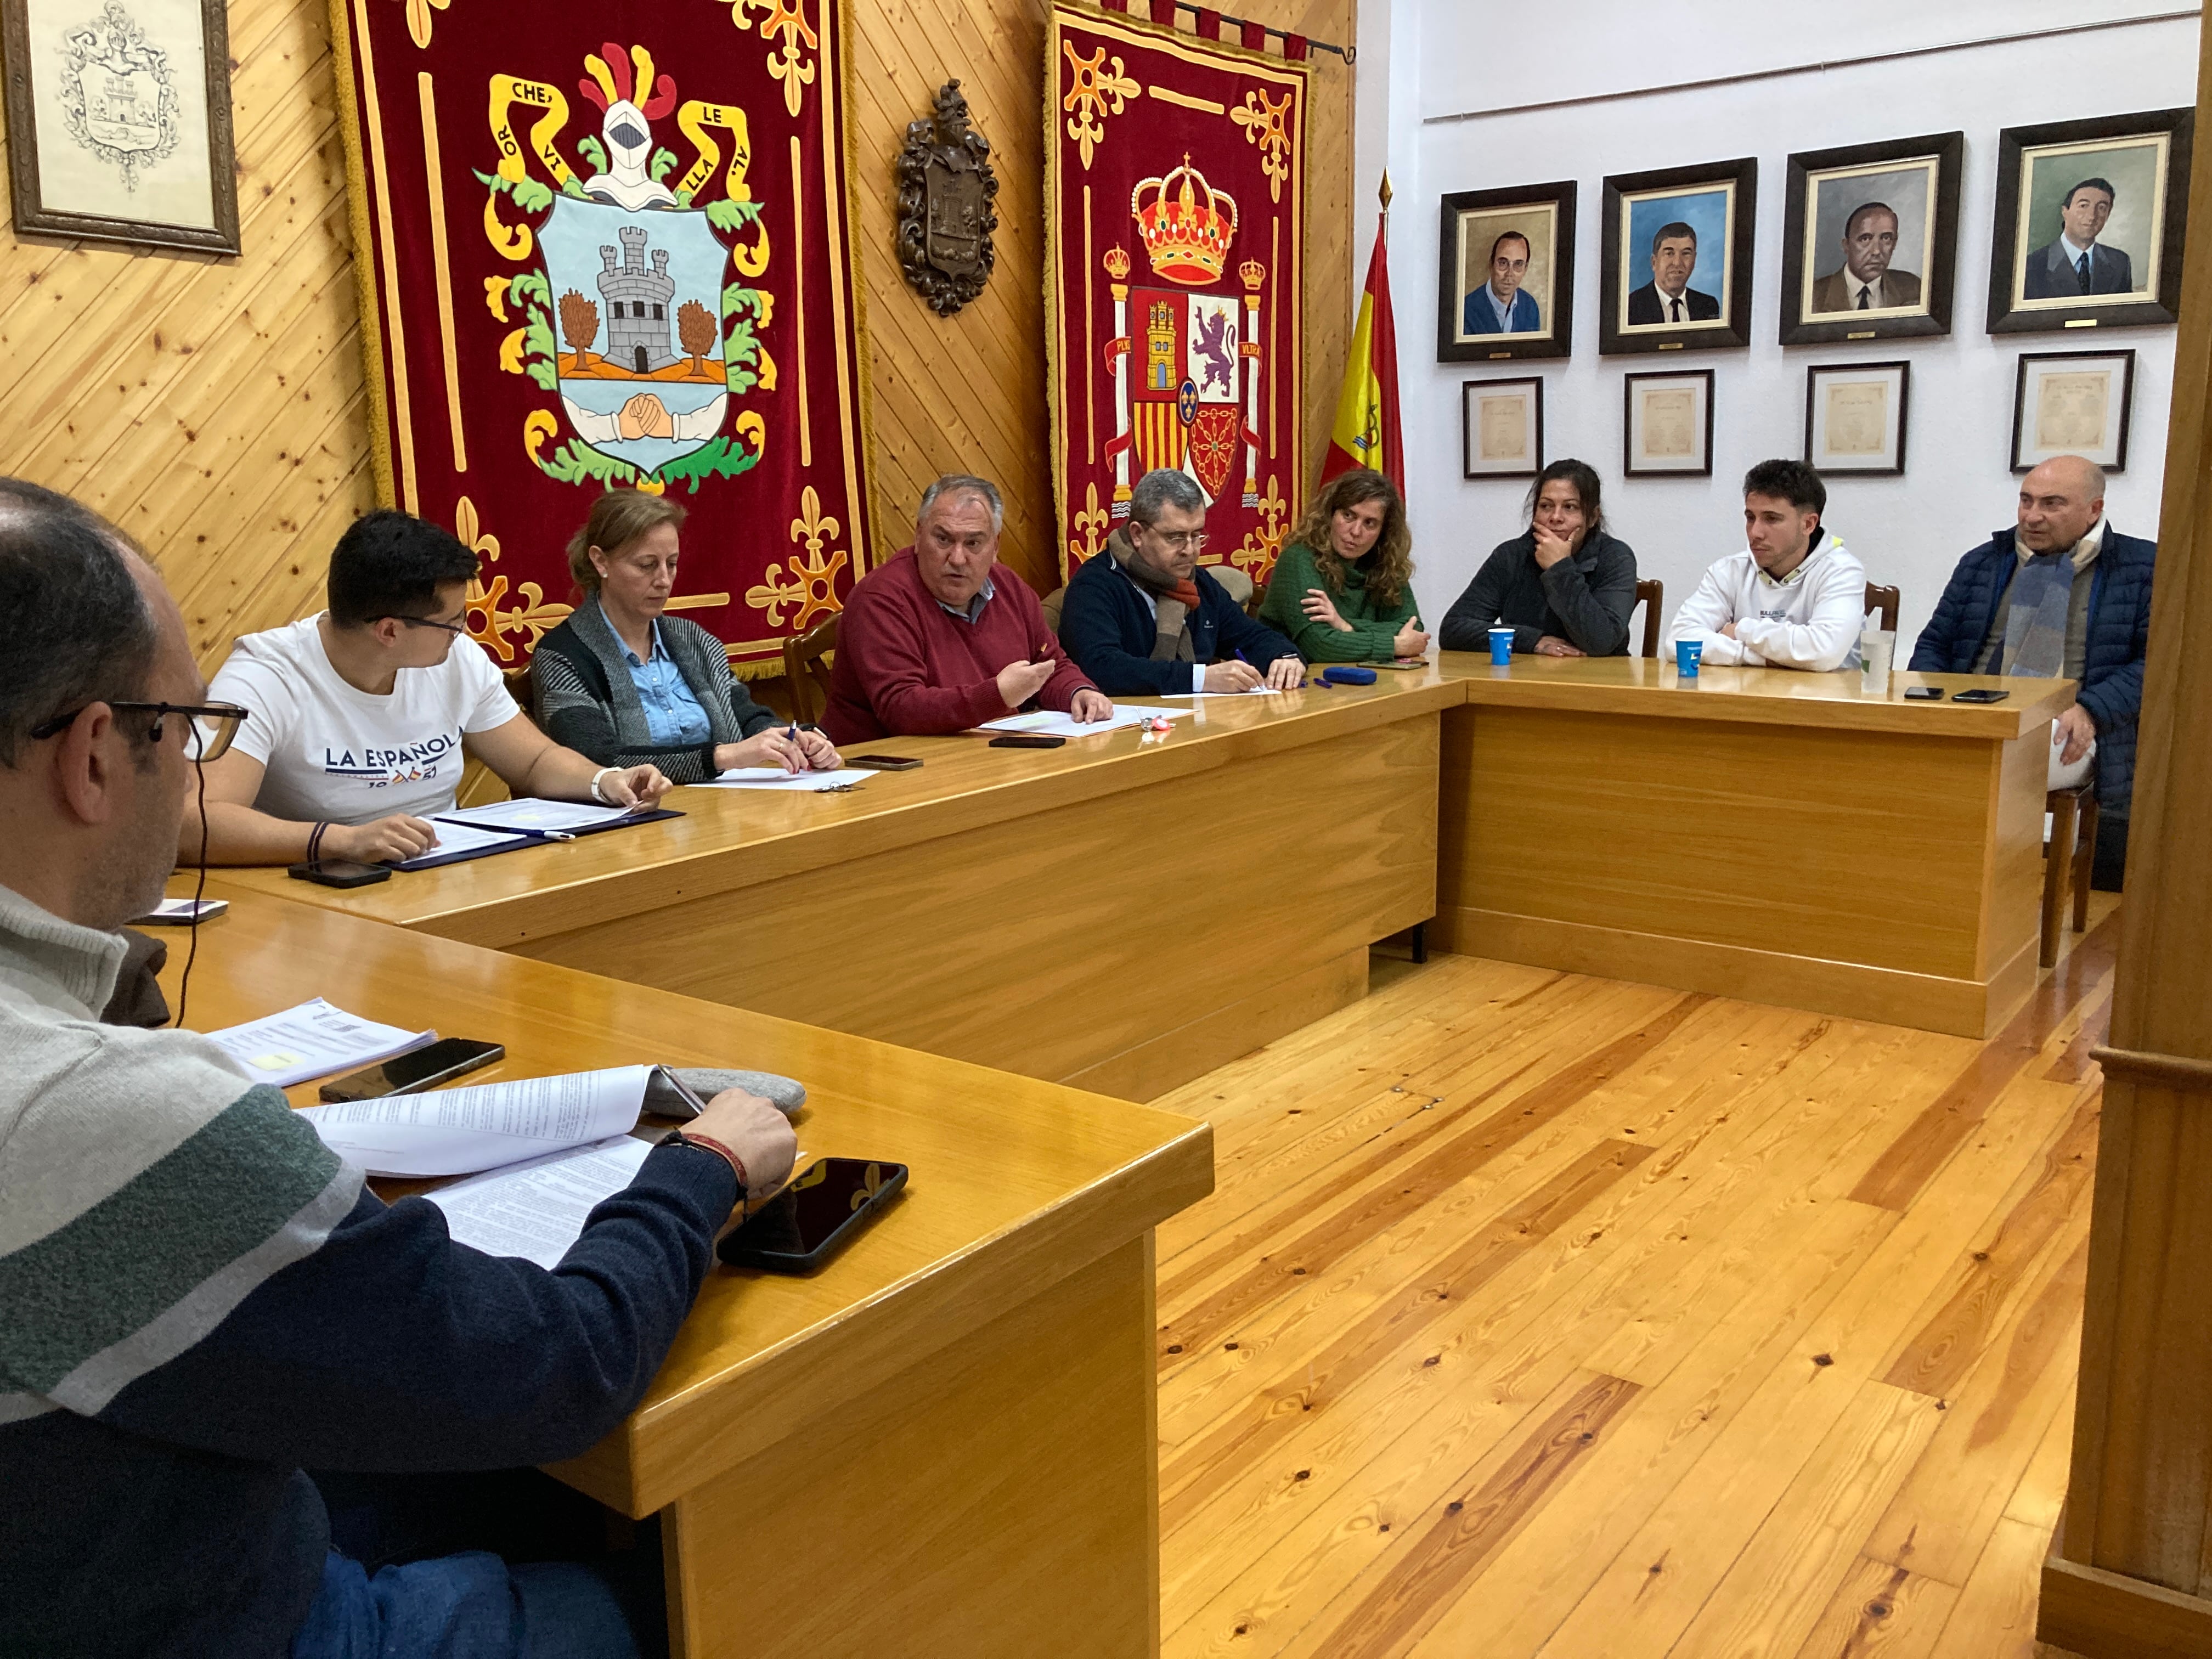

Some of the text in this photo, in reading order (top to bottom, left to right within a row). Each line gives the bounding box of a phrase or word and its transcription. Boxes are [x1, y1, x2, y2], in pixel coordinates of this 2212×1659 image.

[497, 82, 562, 172] OR CHE, VI
[686, 106, 748, 191] LLA LE AL.
[326, 748, 356, 767] LA
